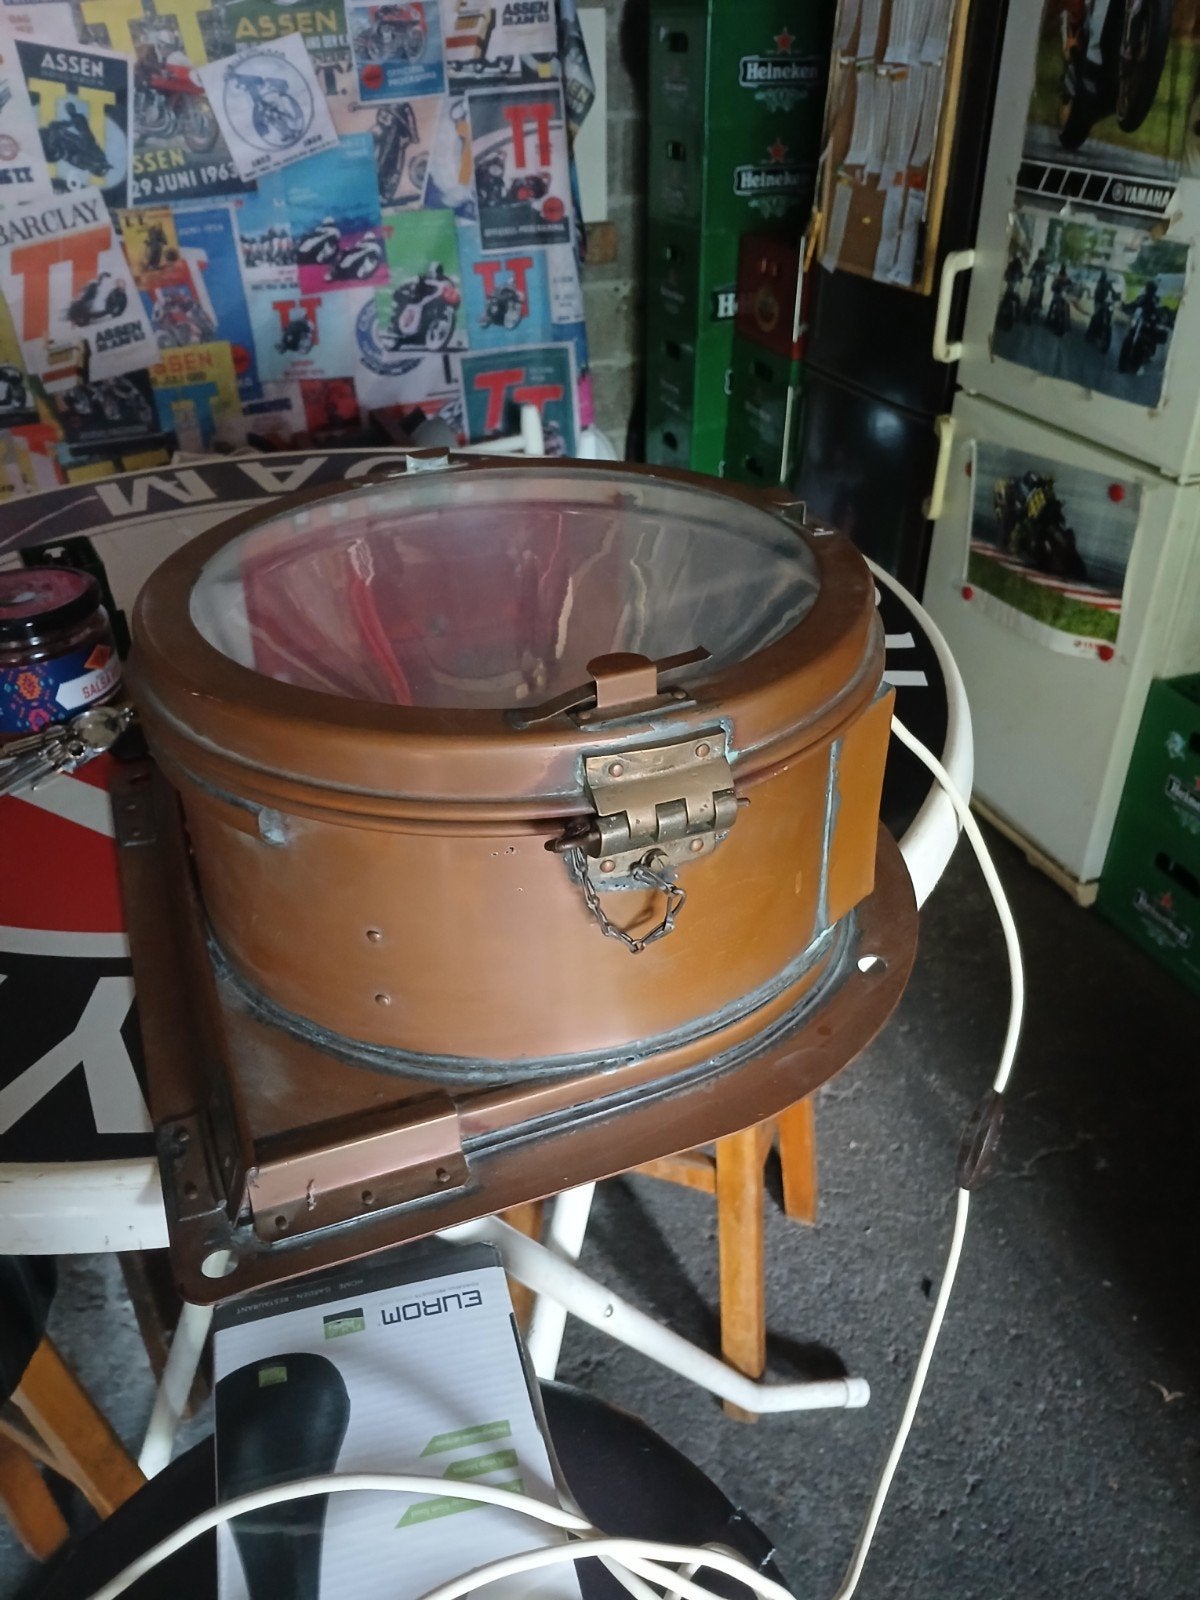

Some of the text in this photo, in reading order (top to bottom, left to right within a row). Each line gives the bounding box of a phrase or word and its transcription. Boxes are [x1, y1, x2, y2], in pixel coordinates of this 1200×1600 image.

[503, 1, 550, 16] ASSEN
[235, 10, 337, 40] ASSEN
[41, 52, 104, 78] ASSEN
[746, 62, 818, 80] Heineken
[504, 103, 556, 169] TT
[133, 150, 187, 174] SSEN
[132, 181, 152, 198] 29
[155, 171, 197, 193] JUNI
[11, 225, 112, 342] TT
[472, 257, 534, 318] TT
[272, 298, 322, 346] TT
[236, 1296, 290, 1315] RESTAURANT
[381, 1289, 483, 1326] EUROM
